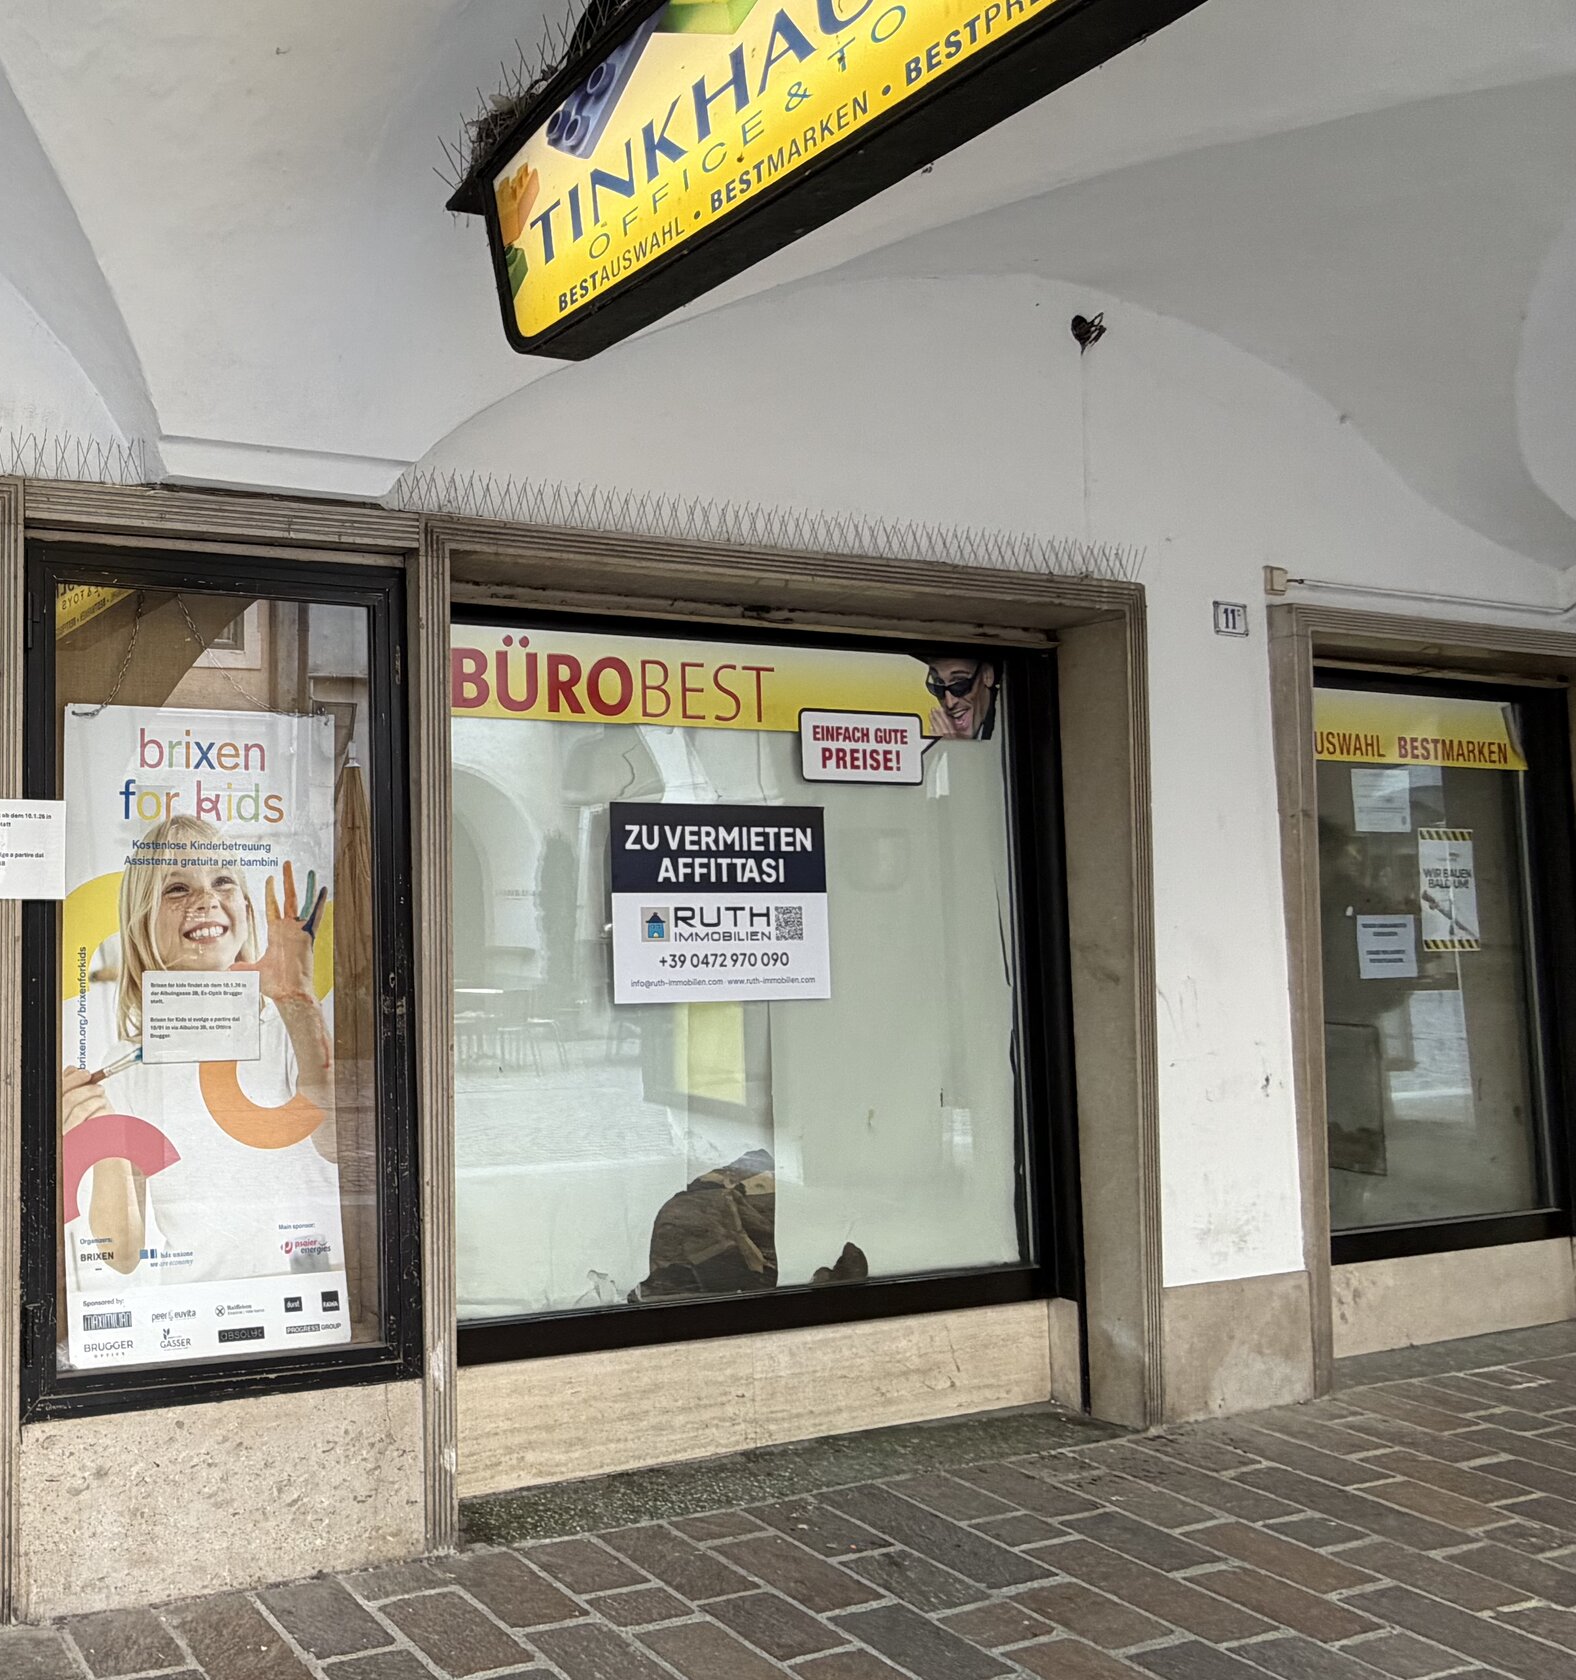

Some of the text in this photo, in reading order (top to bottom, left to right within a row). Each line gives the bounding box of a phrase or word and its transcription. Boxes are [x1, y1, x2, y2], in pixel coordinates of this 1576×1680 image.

[558, 0, 1043, 313] BESTAUSWAHL BESTMARKEN BESTPR
[589, 110, 764, 259] OFFICE
[785, 81, 811, 112] &
[450, 634, 775, 723] BÜROBEST
[812, 724, 908, 745] EINFACH GUTE
[139, 728, 266, 771] brixen
[821, 748, 901, 772] PREISE!
[1397, 736, 1508, 765] BESTMARKEN
[119, 779, 284, 823] for kids
[132, 840, 272, 853] Kostenlose Kinderbetreuung
[624, 824, 813, 852] ZU VERMIETEN
[124, 856, 278, 868] Assistenza gratuita per bambini
[658, 857, 785, 883] AFFITTASI
[1424, 869, 1442, 878] WIR
[674, 906, 771, 928] RUTH
[674, 931, 772, 942] IMMOBILIEN
[659, 952, 790, 968] +39 0472 970 090
[631, 976, 816, 989] info@ruth-immobilien.com www.ruth-immobilien.com
[77, 946, 88, 1070] brixen.org/brixenforkids
[80, 1251, 114, 1262] BRIXEN
[83, 1298, 114, 1307] Sponsored
[84, 1340, 133, 1352] BRUGGER
[160, 1338, 191, 1349] GASSER
